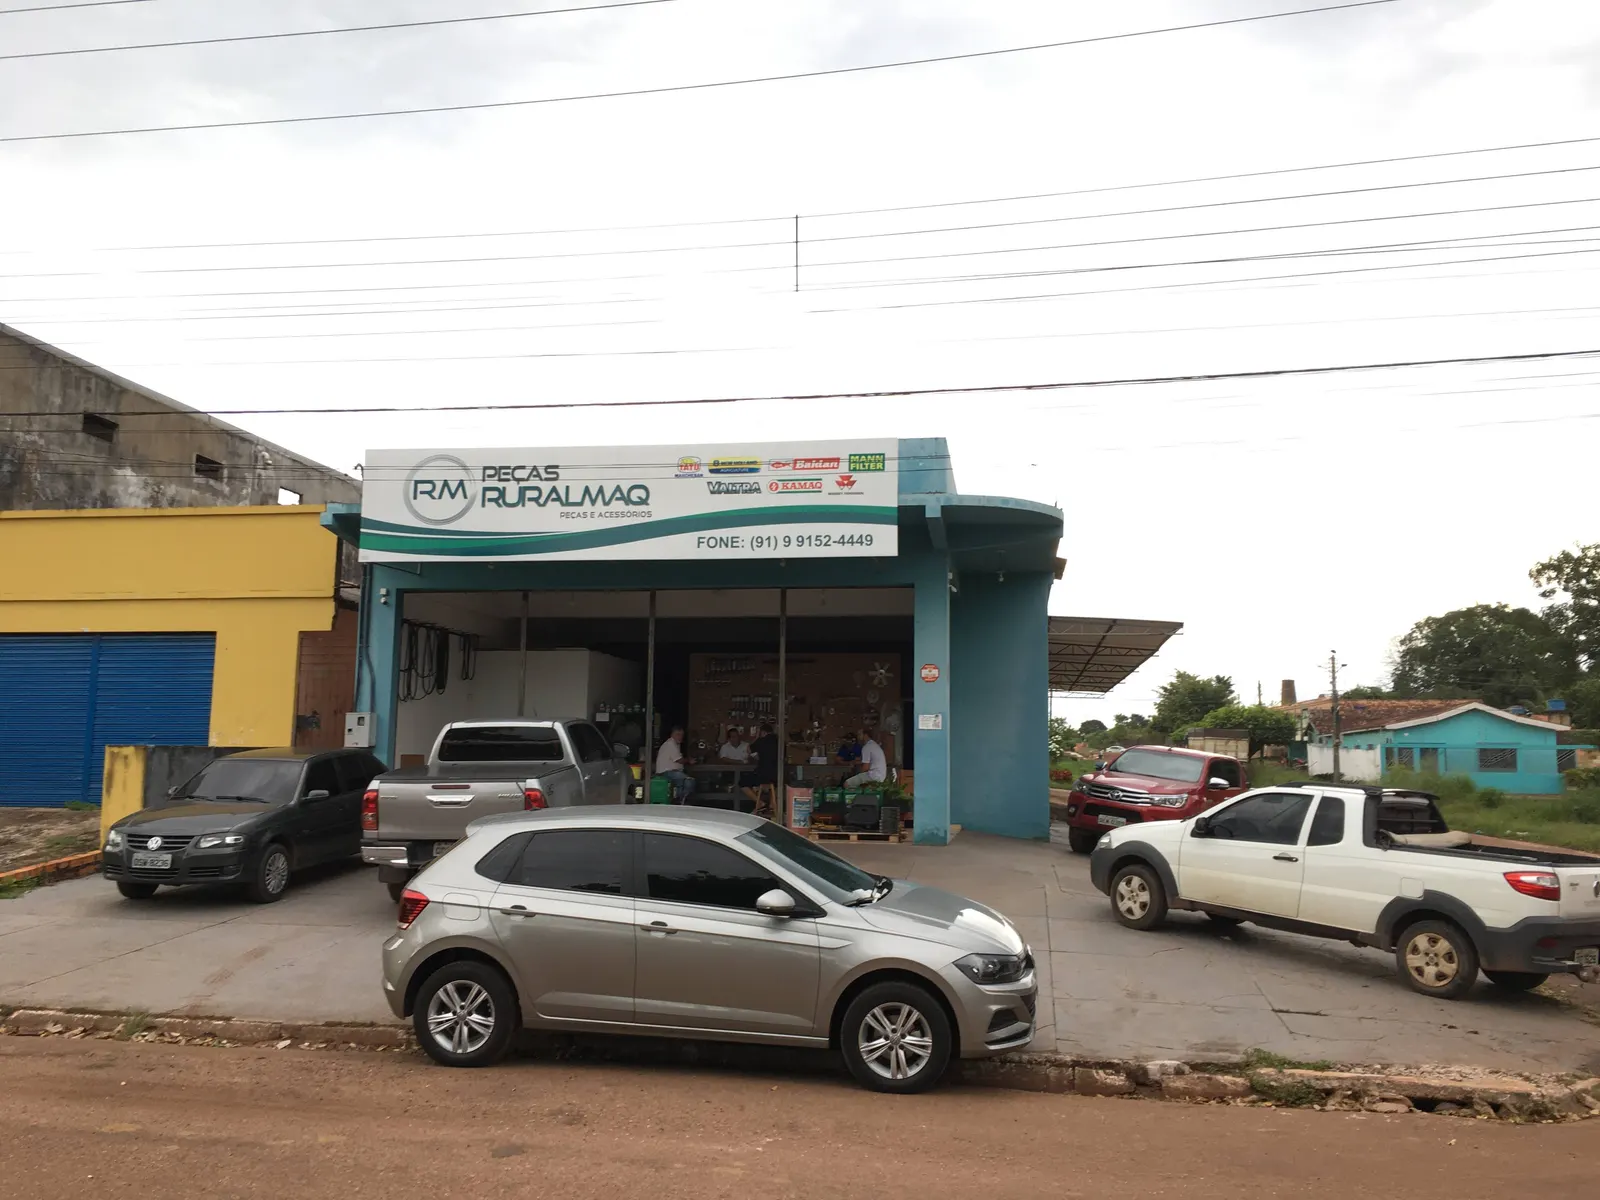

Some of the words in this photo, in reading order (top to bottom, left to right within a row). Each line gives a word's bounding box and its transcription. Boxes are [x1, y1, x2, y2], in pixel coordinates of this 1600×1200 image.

[850, 455, 883, 463] MANN
[850, 462, 883, 472] FILTER
[482, 465, 559, 484] PEÇAS
[413, 479, 468, 500] RM
[481, 484, 650, 508] RURALMAQ
[707, 482, 761, 494] VALTRA
[697, 537, 745, 549] FONE:
[750, 535, 778, 551] (91)
[783, 536, 791, 547] 9
[796, 534, 873, 547] 9152-4449
